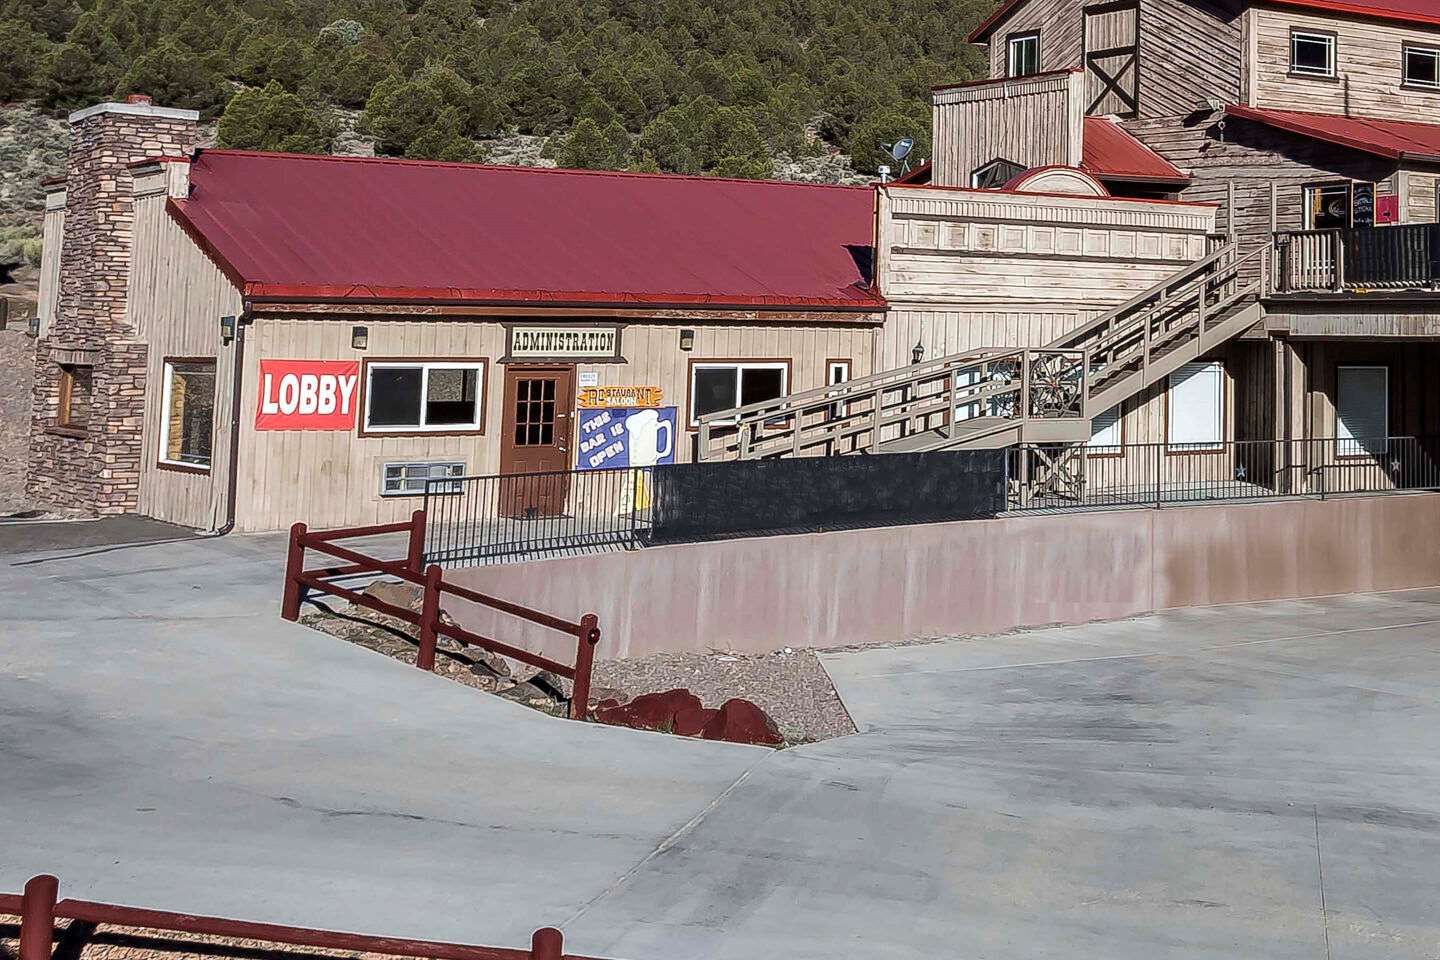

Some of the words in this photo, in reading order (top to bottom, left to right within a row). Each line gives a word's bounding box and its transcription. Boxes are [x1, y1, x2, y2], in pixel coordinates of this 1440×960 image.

[513, 332, 614, 351] ADMINISTRATION
[261, 372, 358, 416] LOBBY
[588, 388, 652, 406] RESTAURANT
[606, 396, 636, 406] SALOON
[582, 411, 611, 434] THIS
[579, 433, 607, 454] BAR
[609, 422, 625, 437] IS
[589, 440, 625, 468] OPEN
